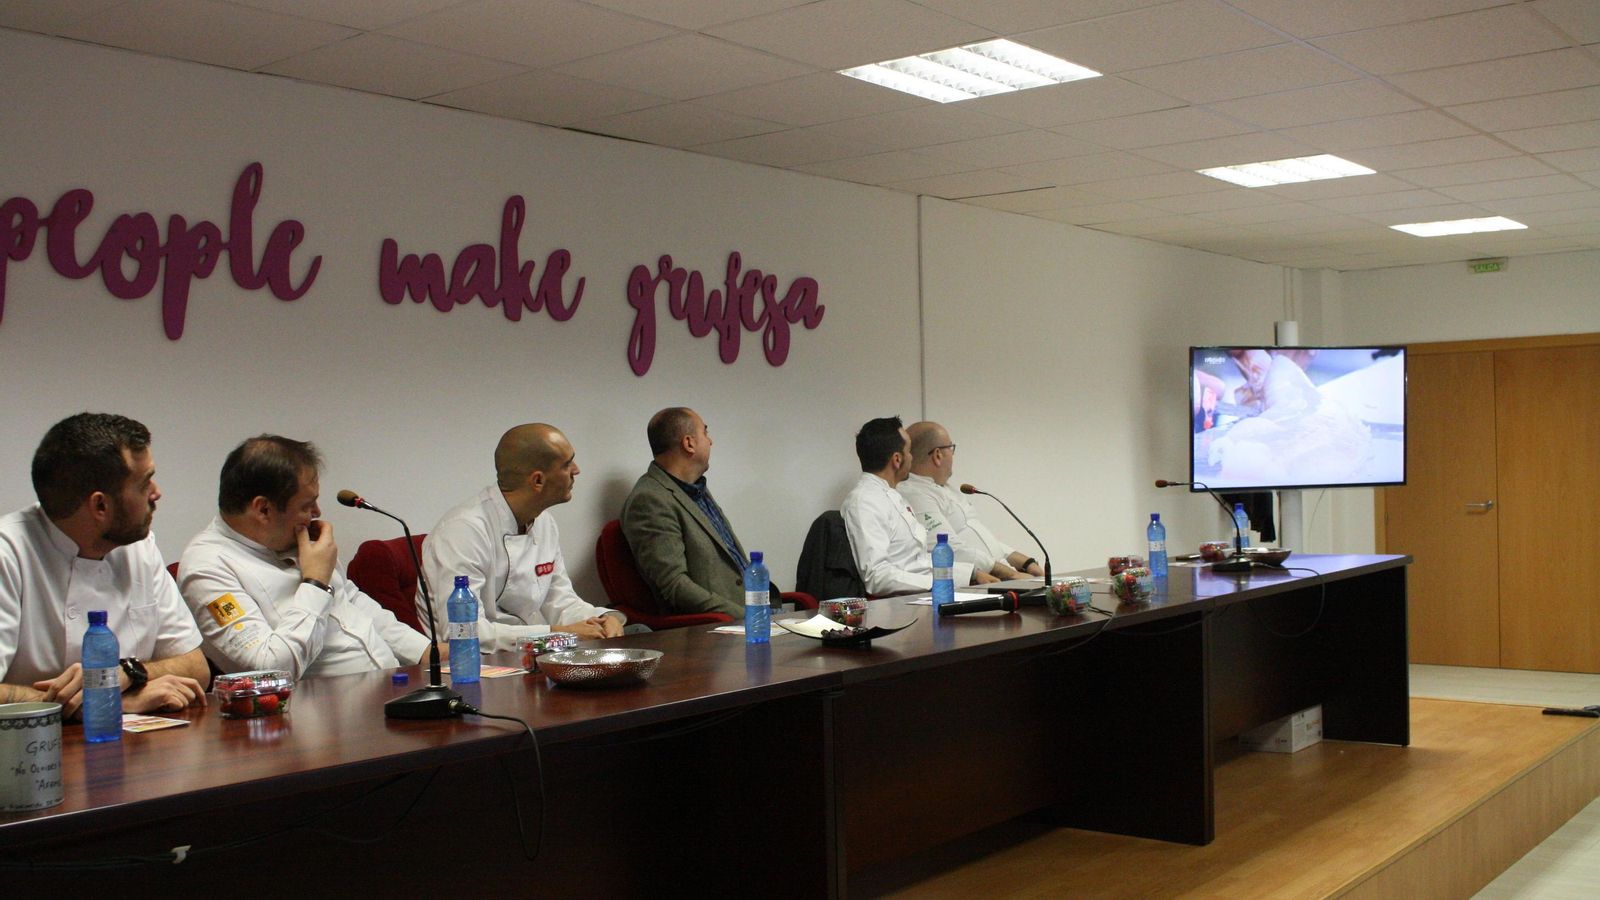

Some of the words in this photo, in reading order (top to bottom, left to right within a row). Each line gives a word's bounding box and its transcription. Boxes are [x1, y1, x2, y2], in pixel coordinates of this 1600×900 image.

[0, 162, 322, 340] people
[380, 195, 585, 322] make
[627, 251, 825, 376] grufesa
[26, 739, 60, 756] GRUF
